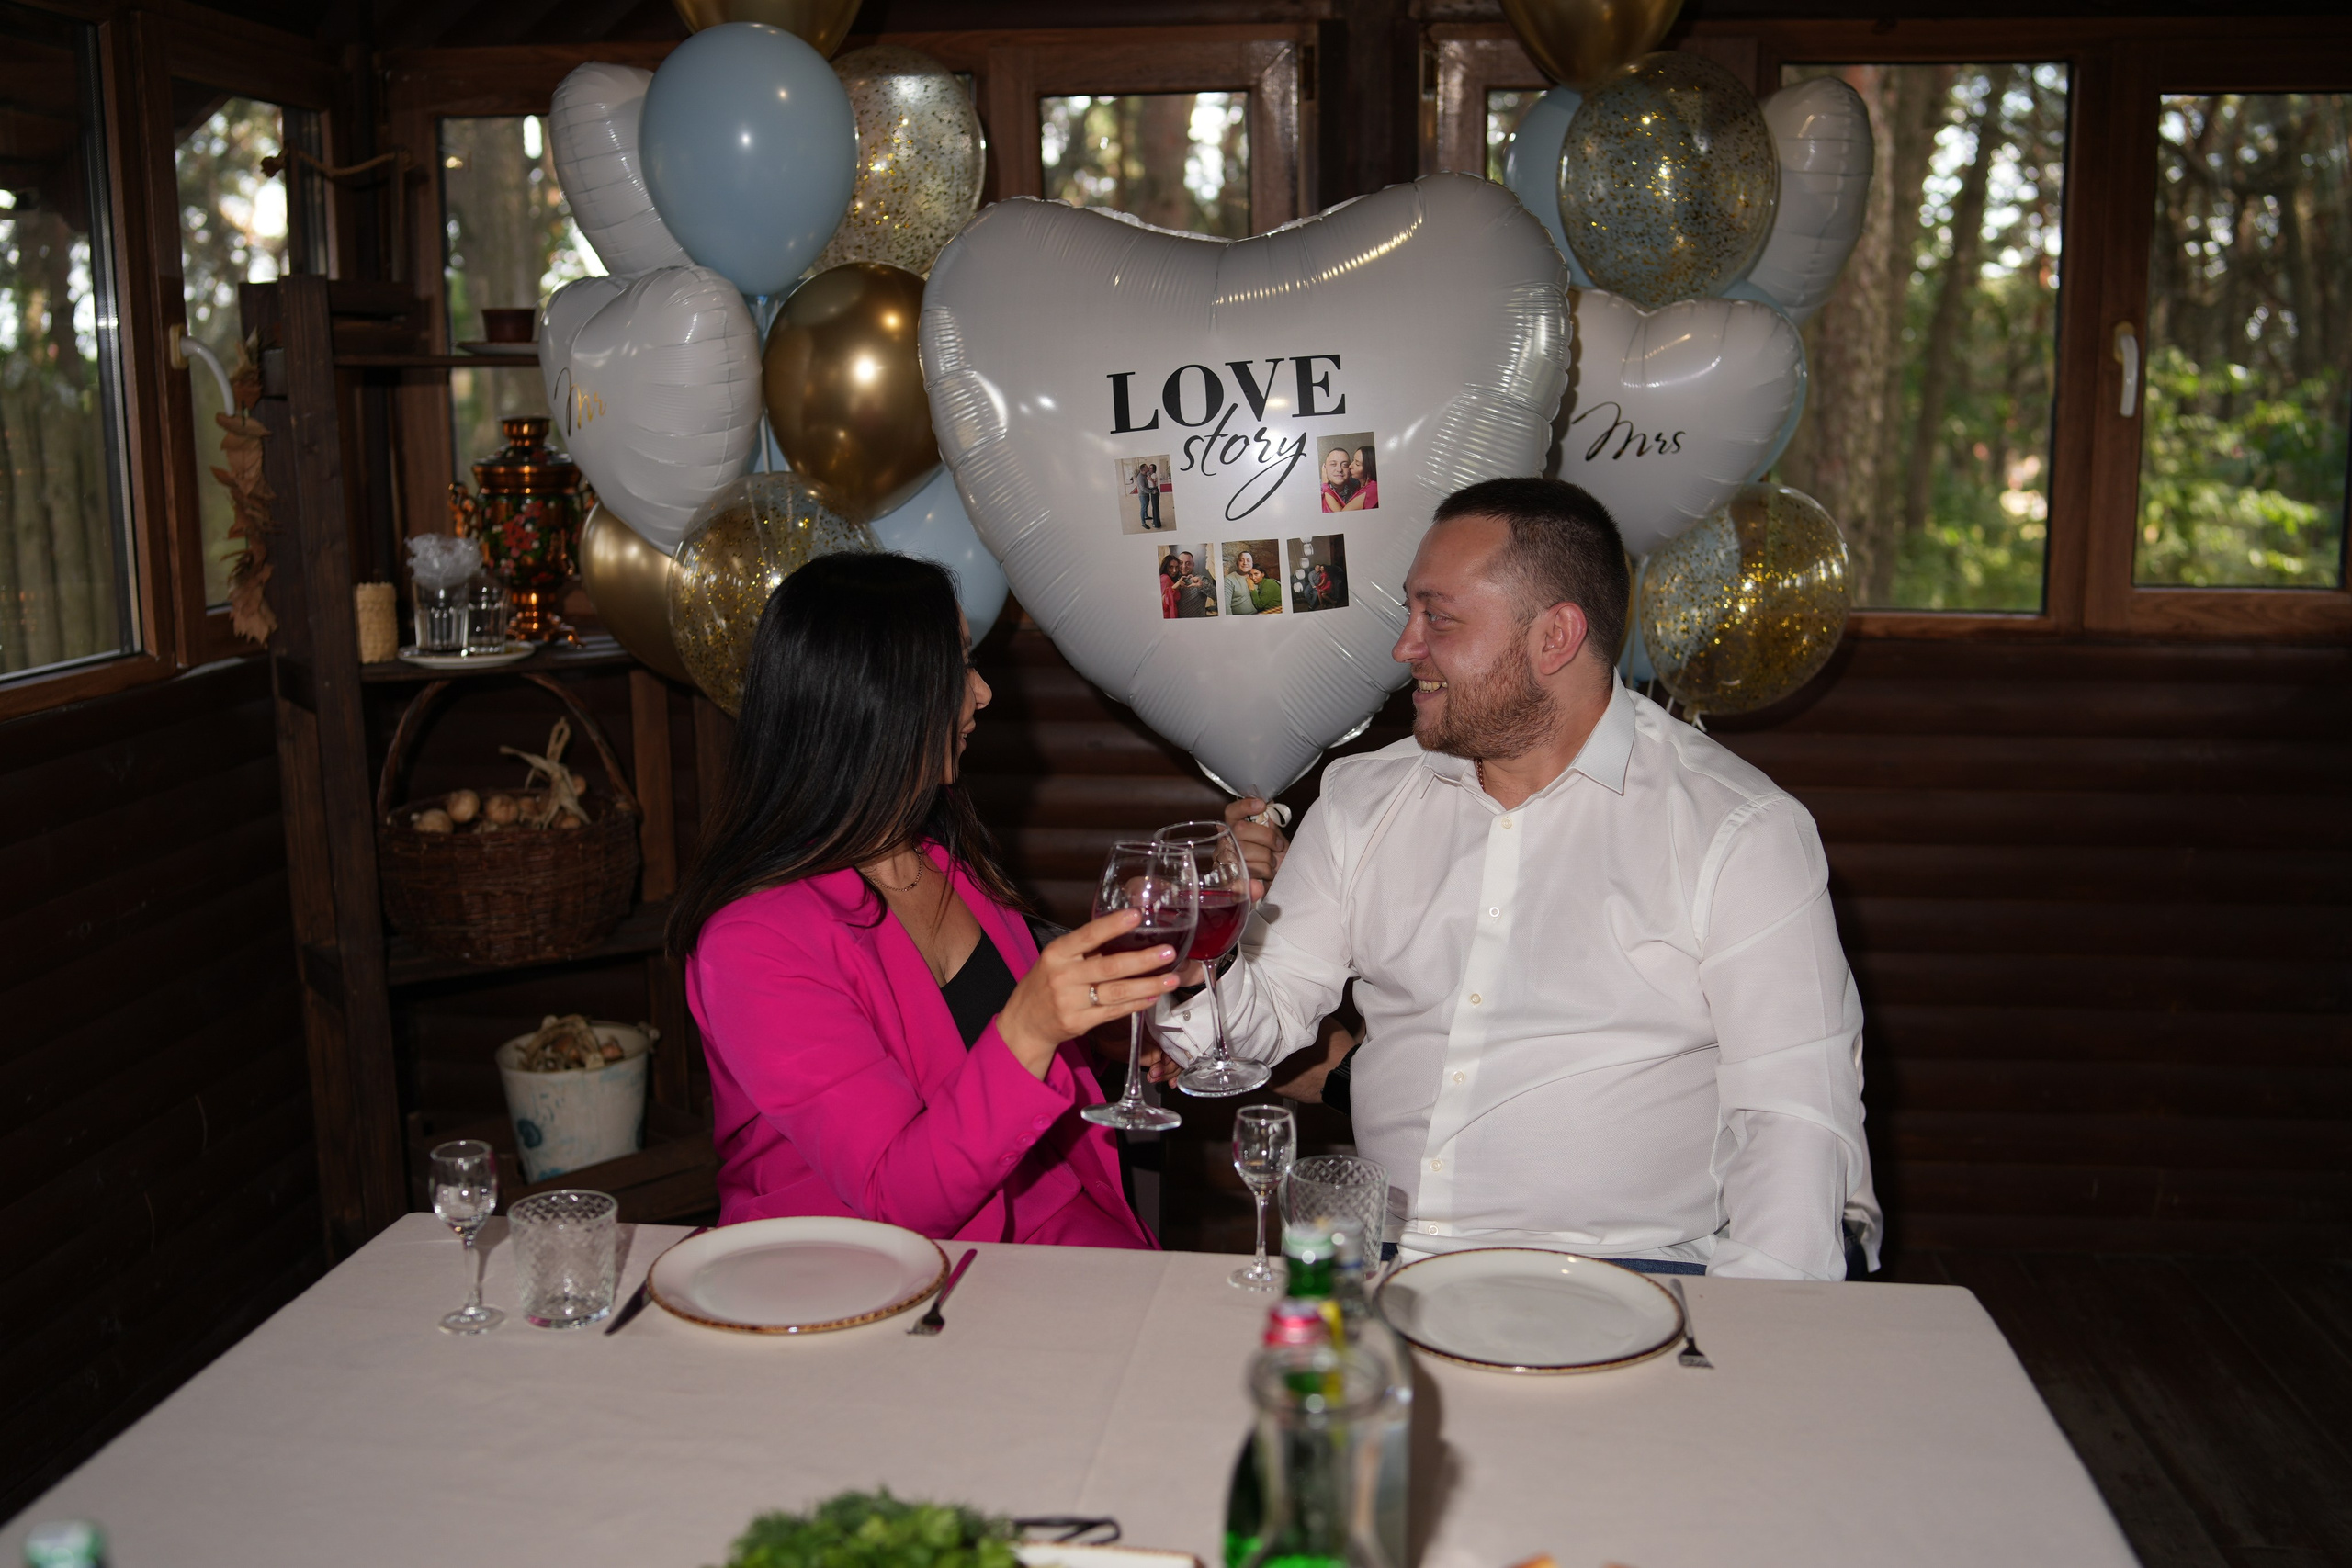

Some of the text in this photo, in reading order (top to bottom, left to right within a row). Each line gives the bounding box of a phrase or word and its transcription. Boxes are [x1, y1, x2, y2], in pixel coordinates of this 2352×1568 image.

[554, 367, 607, 437] Mr
[1106, 354, 1346, 434] LOVE
[1571, 401, 1686, 461] Mrs
[1180, 402, 1306, 521] story
